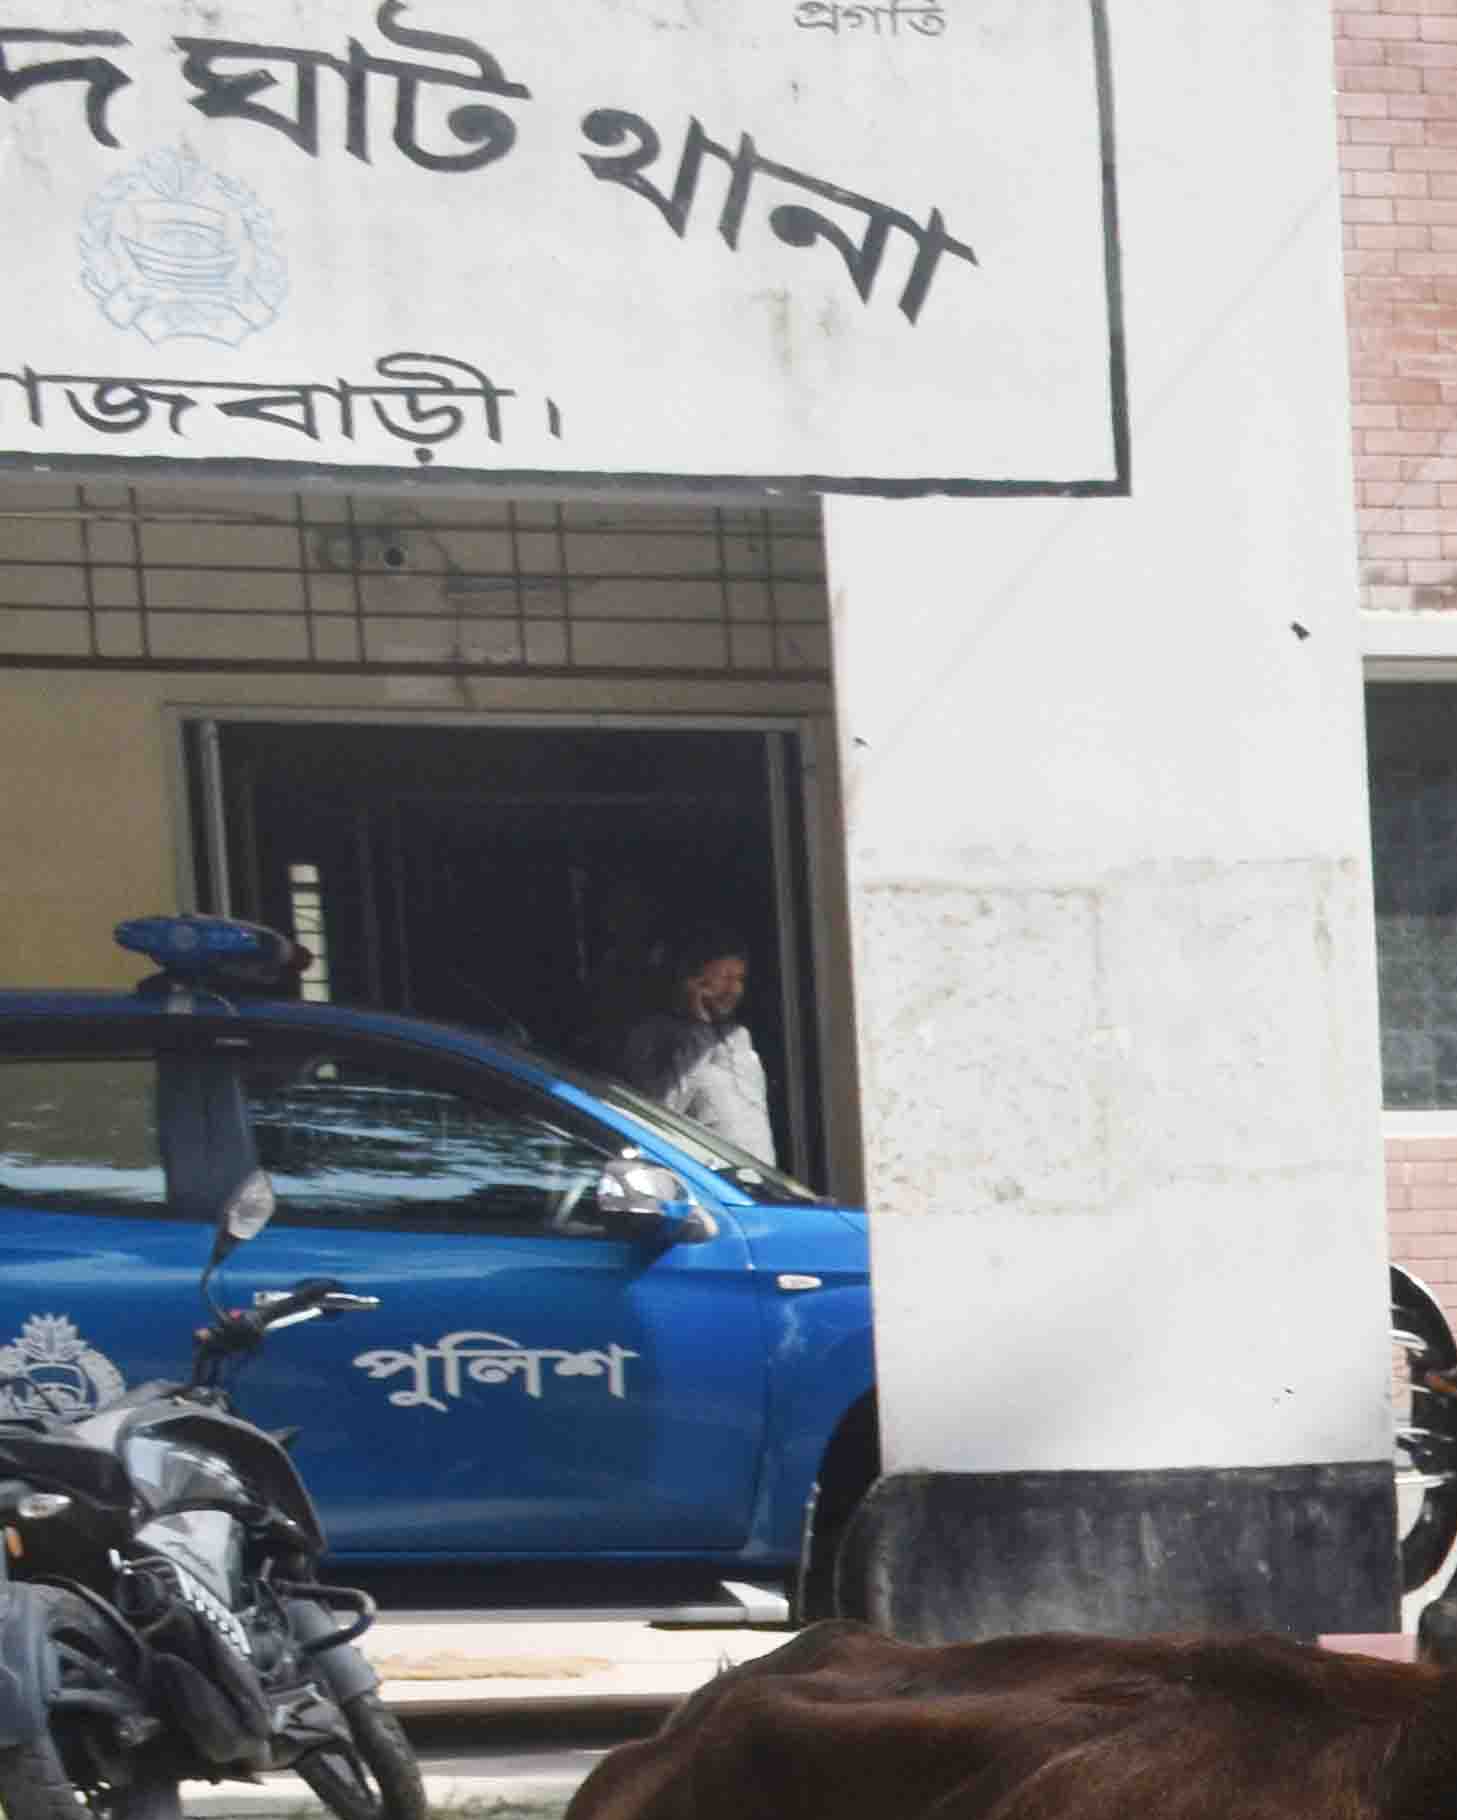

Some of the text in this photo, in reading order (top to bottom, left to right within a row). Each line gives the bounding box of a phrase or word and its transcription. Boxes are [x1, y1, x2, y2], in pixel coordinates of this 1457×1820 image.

[172, 0, 533, 173] ঘাট
[578, 107, 979, 326] থানা
[0, 351, 562, 466] াজবাড়ী।
[353, 1330, 641, 1412] পুলিশ
